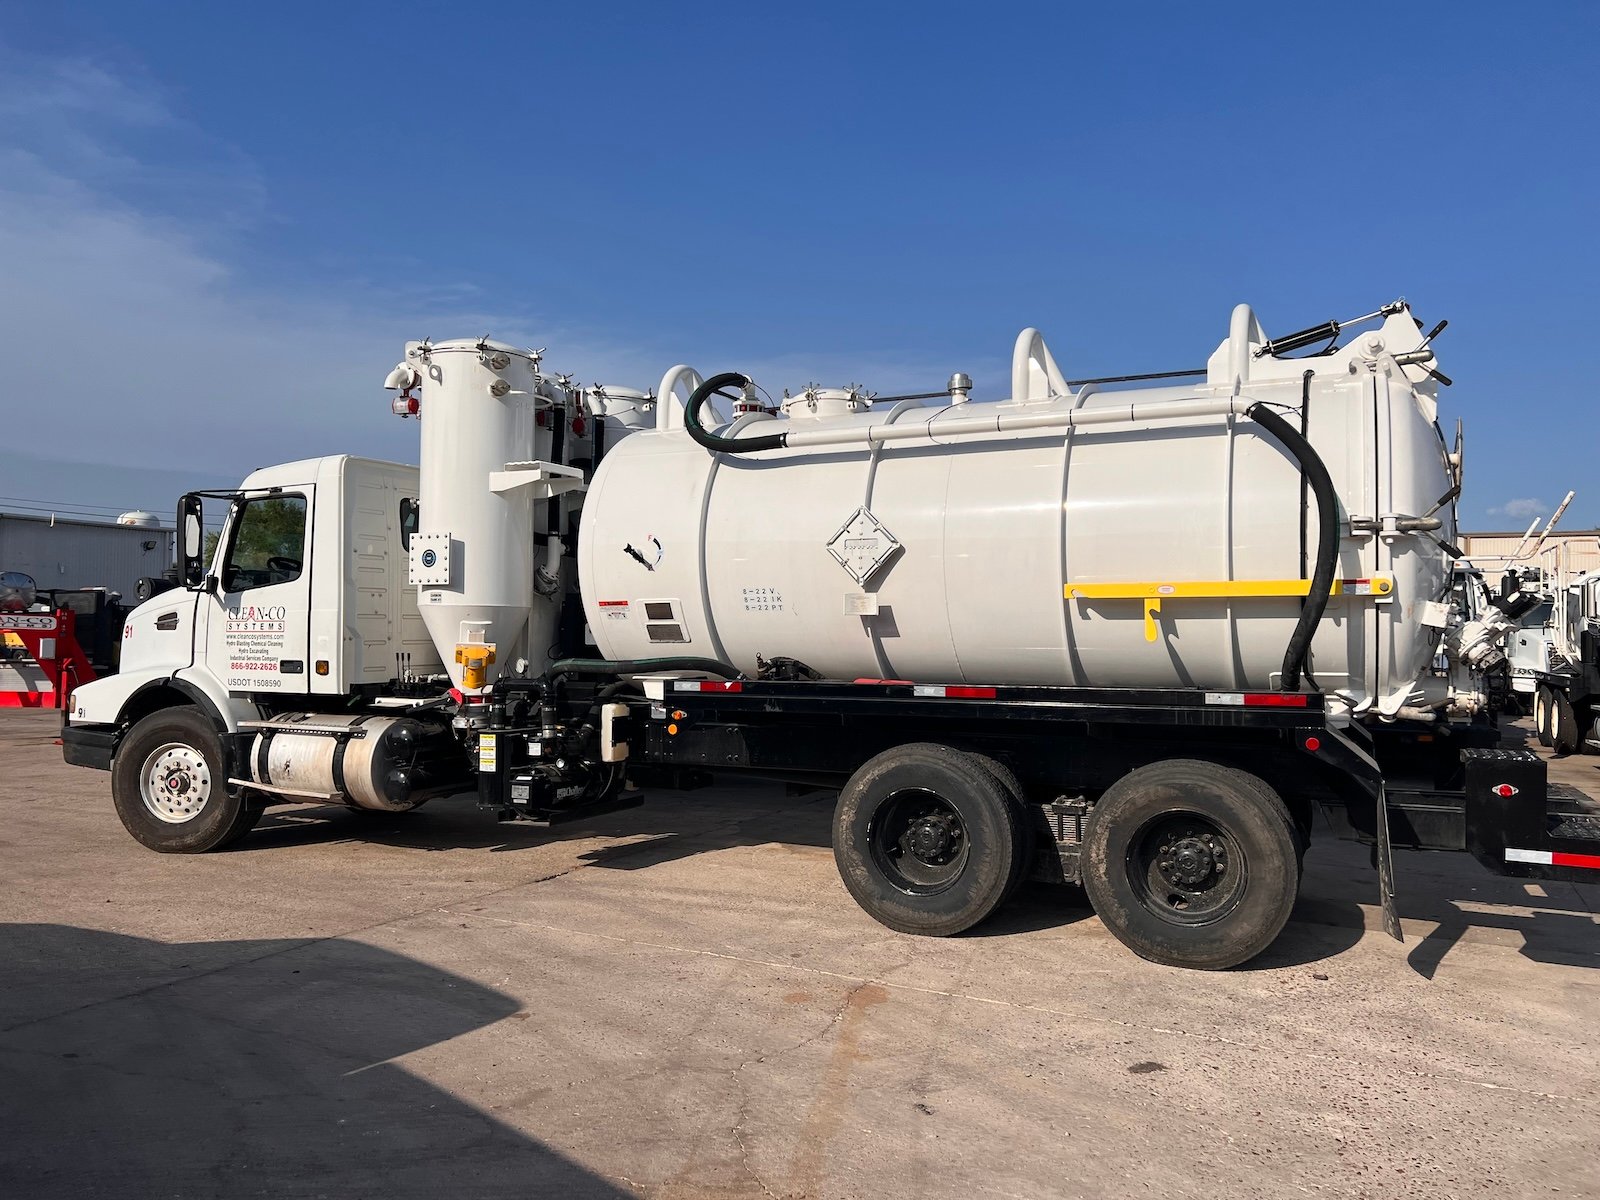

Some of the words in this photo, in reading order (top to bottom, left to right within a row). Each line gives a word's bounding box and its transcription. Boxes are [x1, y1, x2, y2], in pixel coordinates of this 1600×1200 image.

[228, 606, 286, 620] CLEAN-CO
[228, 622, 283, 630] SYSTEMS
[124, 625, 133, 638] 91
[230, 662, 278, 671] 866-922-2626
[227, 678, 251, 687] USDOT
[253, 679, 282, 687] 1508590
